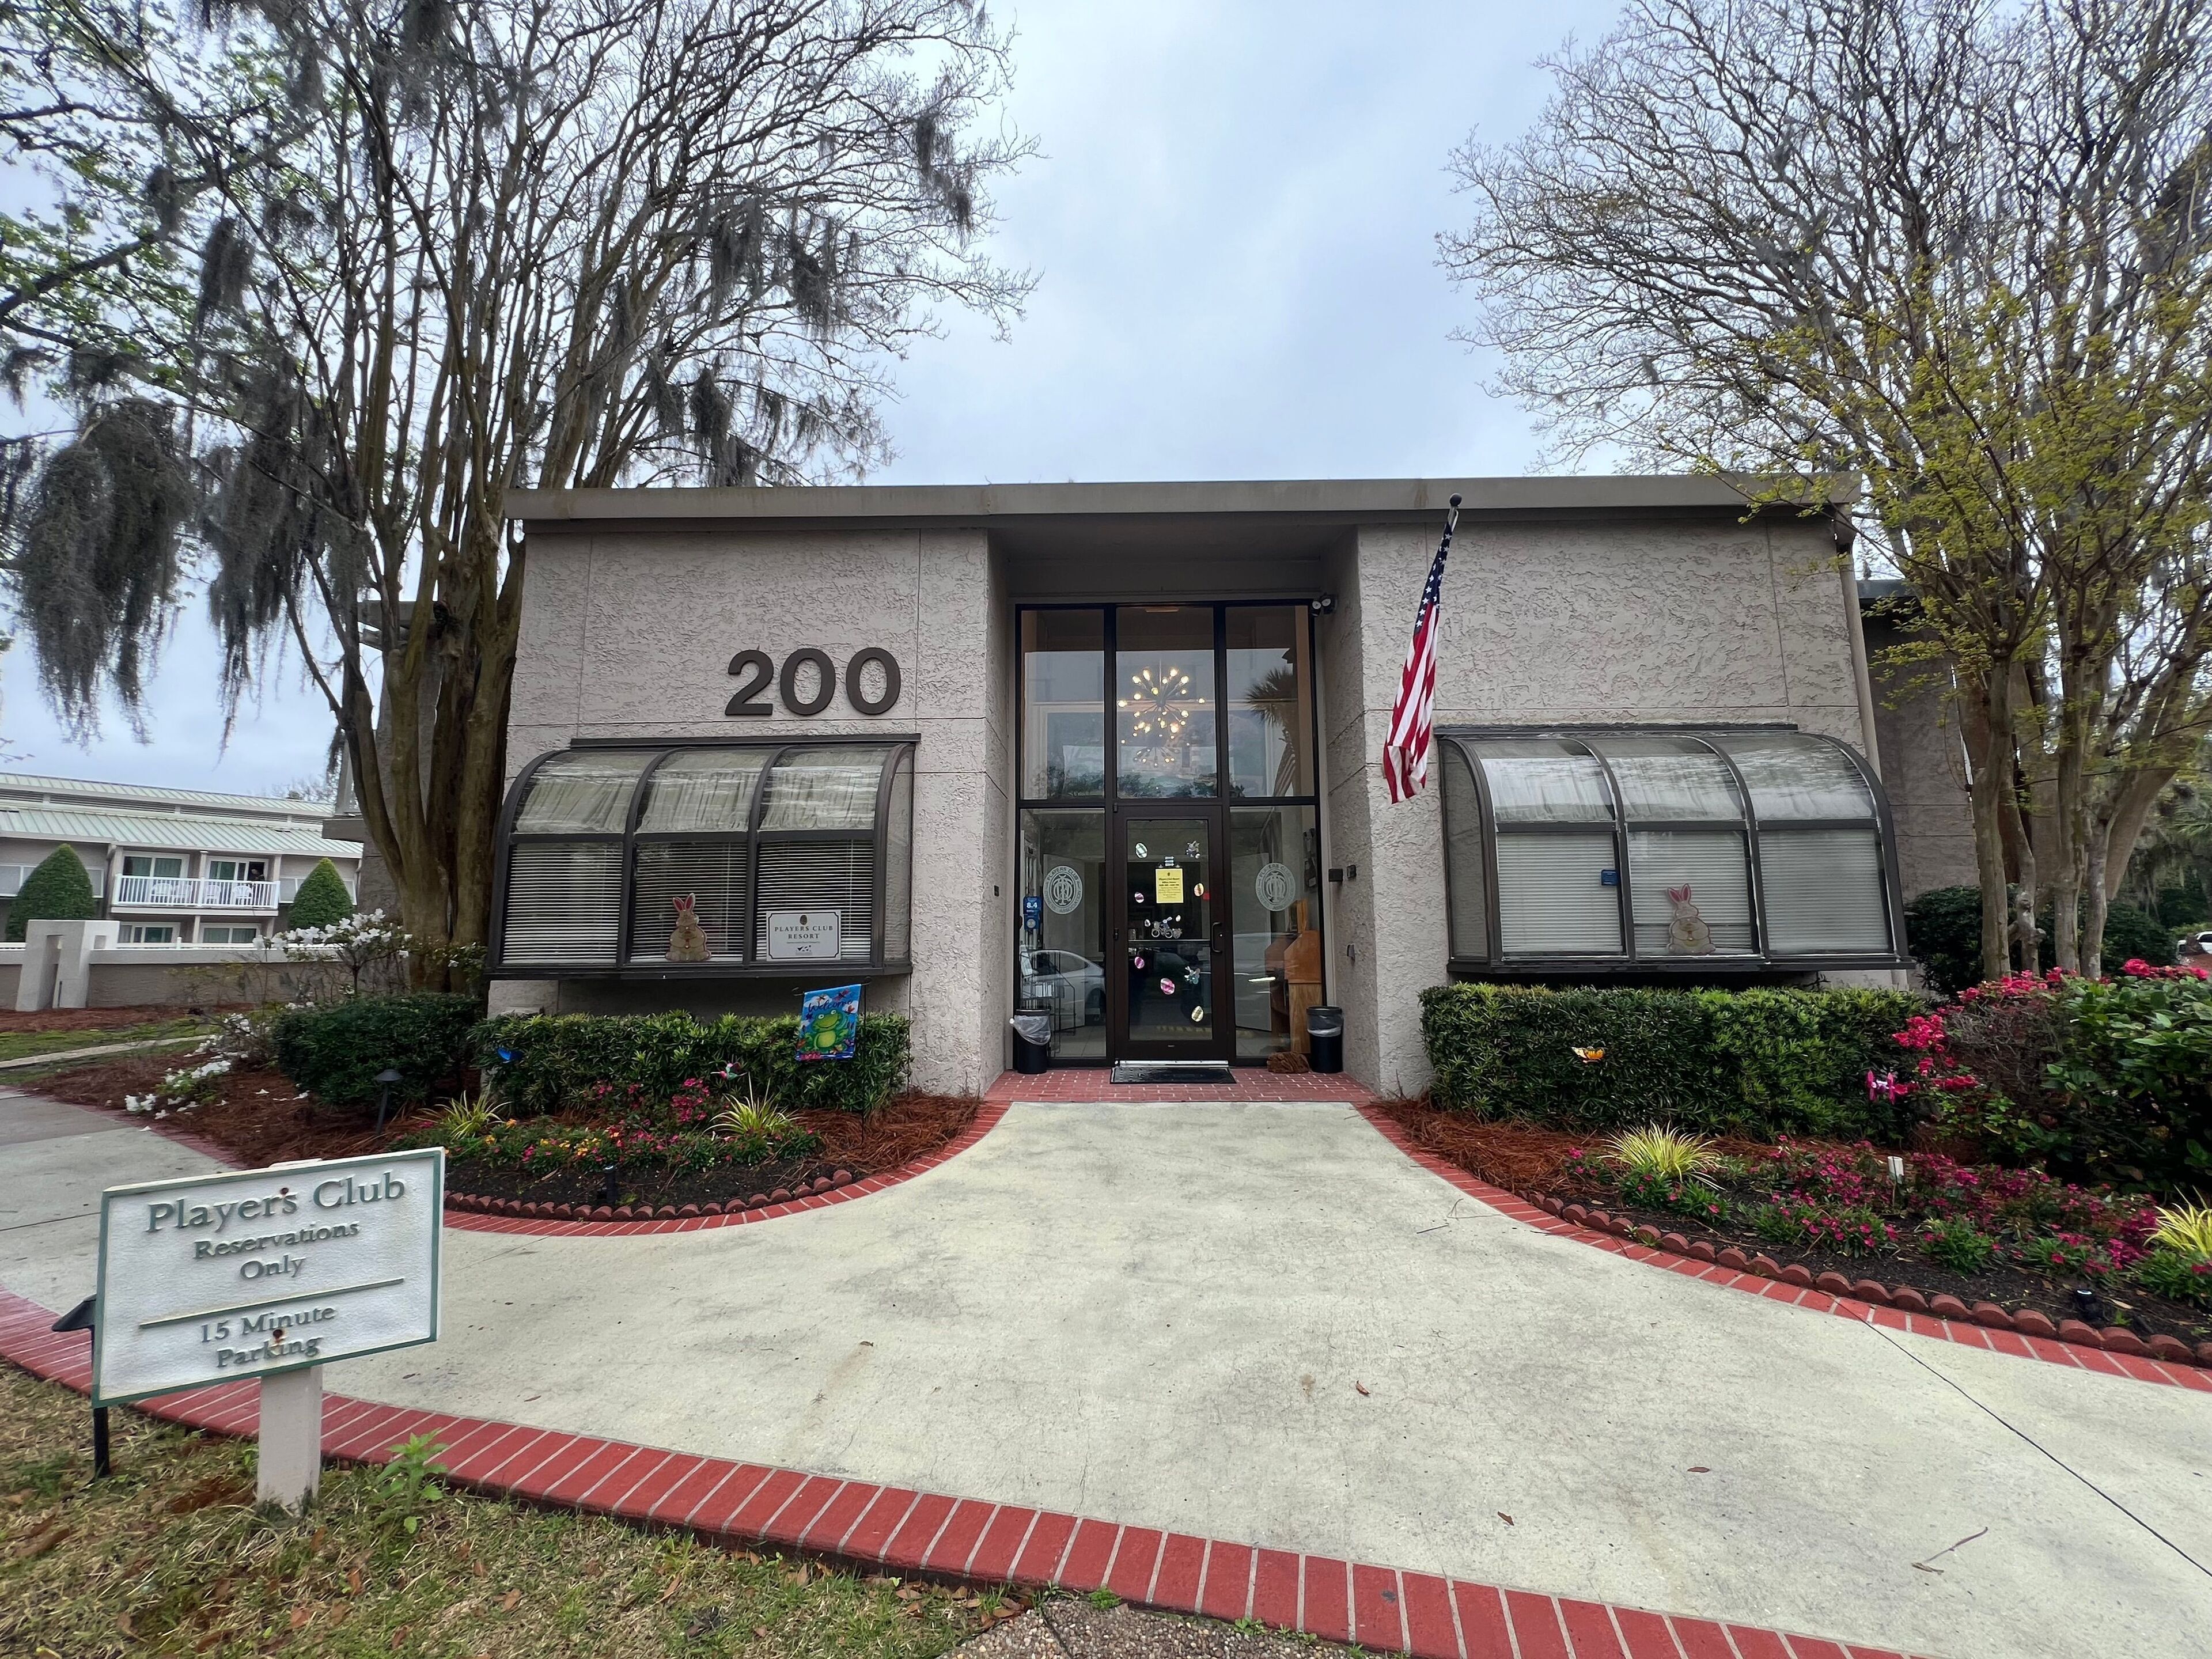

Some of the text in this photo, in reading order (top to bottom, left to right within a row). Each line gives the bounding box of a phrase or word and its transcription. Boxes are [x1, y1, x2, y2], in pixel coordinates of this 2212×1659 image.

[725, 647, 902, 715] 200
[1046, 867, 1067, 880] PLAYERS
[808, 999, 853, 1012] Welcome
[313, 1172, 406, 1209] Club
[193, 1220, 360, 1259] Reservations
[239, 1254, 306, 1279] Only
[201, 1307, 336, 1343] 15 Minute
[216, 1336, 323, 1368] Parking
